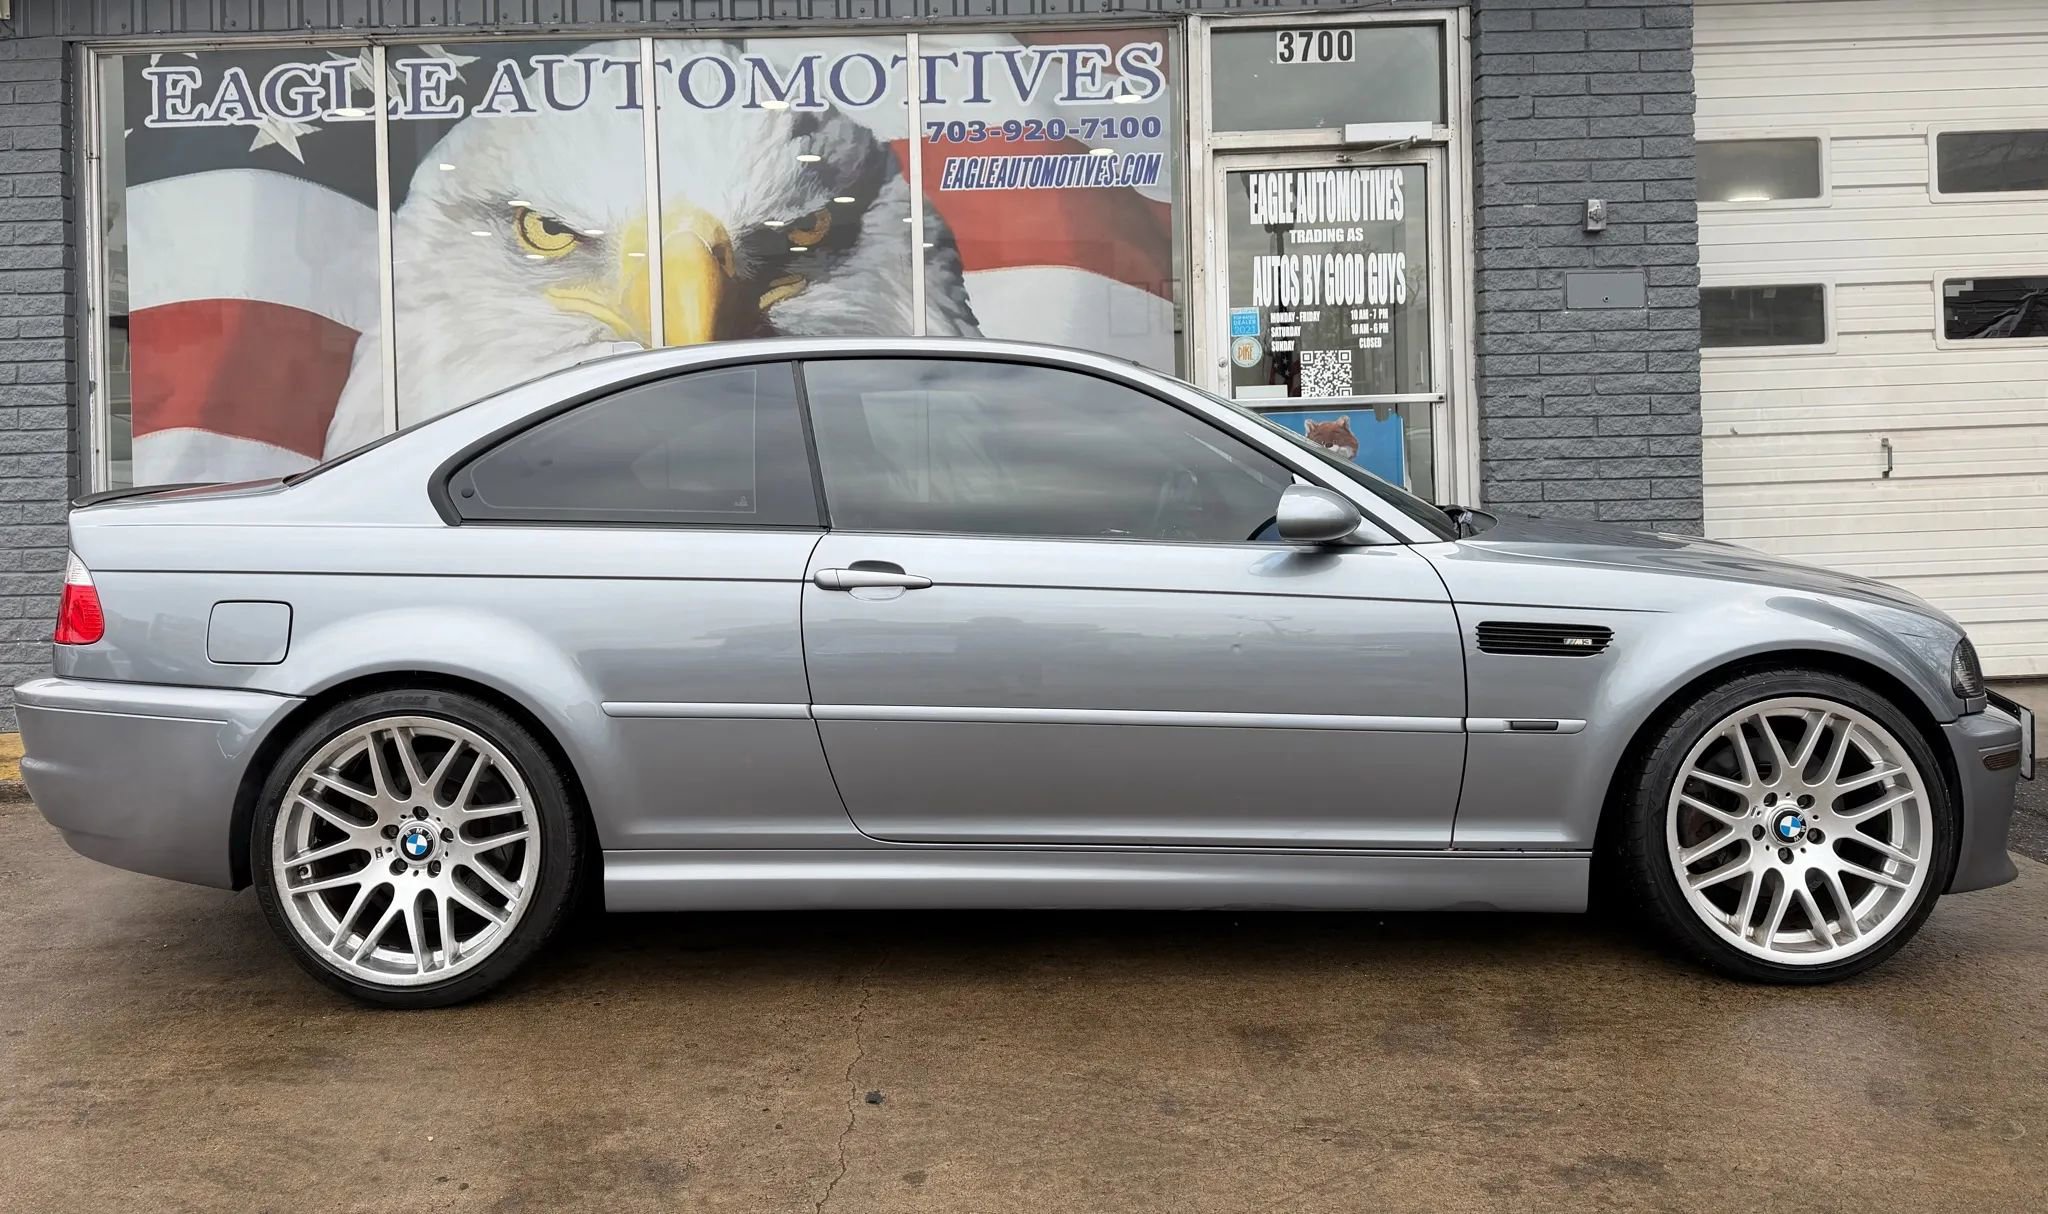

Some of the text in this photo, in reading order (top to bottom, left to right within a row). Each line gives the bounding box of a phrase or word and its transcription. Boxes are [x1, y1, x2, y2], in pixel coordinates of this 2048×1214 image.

[1278, 30, 1353, 63] 3700
[144, 43, 1163, 127] EAGLE AUTOMOTIVES
[926, 115, 1163, 144] 703-920-7100
[941, 152, 1163, 191] EAGLEAUTOMOTIVES.COM
[1250, 169, 1404, 224] EAGLE AUTOMOTIVES
[1289, 227, 1364, 244] TRADING AS
[1253, 252, 1406, 307] AUTOS BY GOOD GUYS
[1270, 312, 1296, 323] MONDAY
[1299, 311, 1321, 322] FRIDAY
[1351, 309, 1358, 321] 10
[1358, 309, 1369, 320] AM
[1373, 309, 1377, 320] 7
[1378, 308, 1389, 319] PM
[1234, 325, 1256, 334] 2021
[1271, 326, 1301, 338] SATURDAY
[1351, 323, 1359, 335] 10
[1359, 323, 1370, 334] AM
[1373, 323, 1378, 334] 6
[1379, 322, 1389, 334] PM
[1271, 340, 1295, 352] SUNDAY
[1359, 337, 1382, 349] CLOSED
